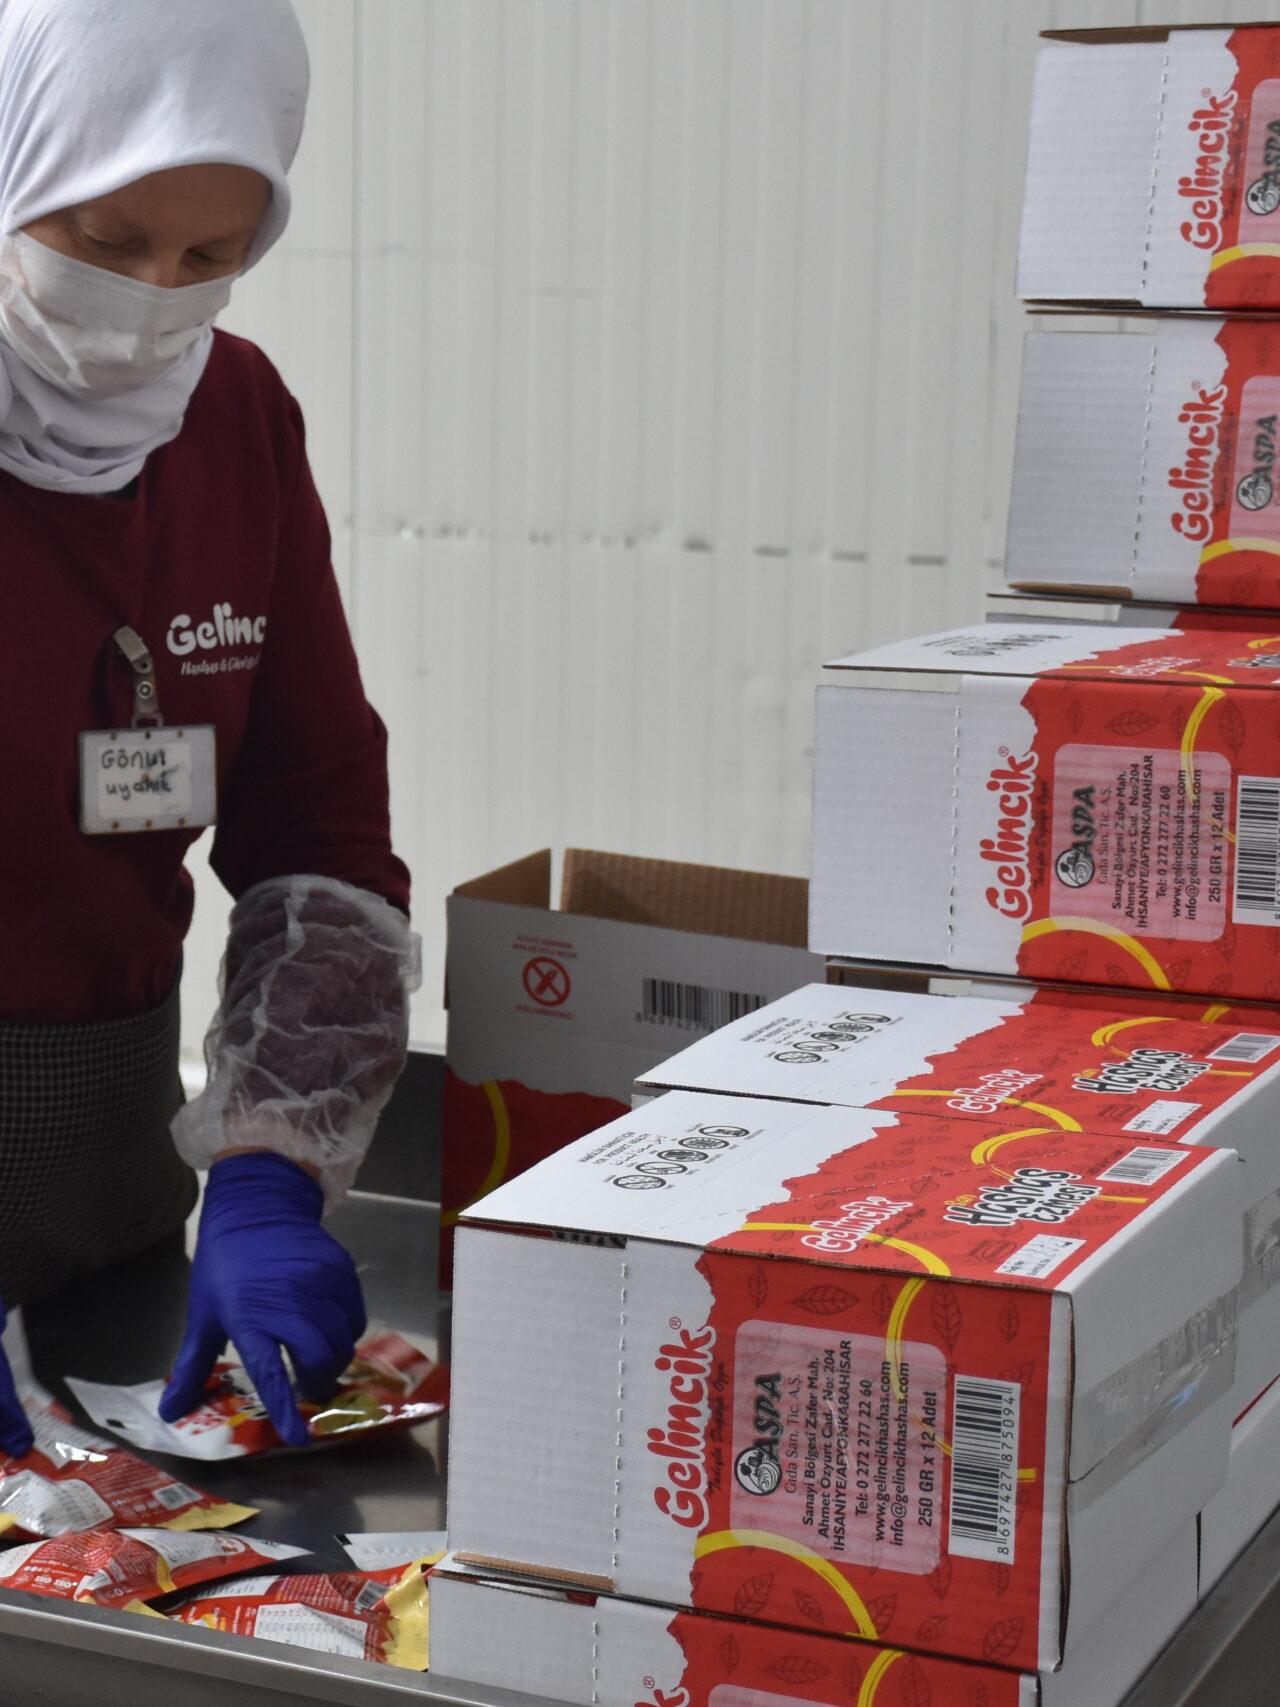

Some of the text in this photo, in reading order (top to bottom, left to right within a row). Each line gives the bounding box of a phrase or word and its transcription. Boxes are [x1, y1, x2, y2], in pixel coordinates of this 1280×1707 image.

[1178, 90, 1237, 249] Gelincik
[1168, 388, 1224, 541] Gelincik
[1252, 414, 1278, 483] ASPA
[1072, 785, 1097, 857] ASPA
[1115, 801, 1126, 830] Zafer
[1116, 770, 1128, 799] Mah.
[1128, 813, 1139, 837] Cad.
[1130, 763, 1140, 783] 204
[980, 755, 1035, 919] Gelincik
[1112, 875, 1125, 910] Sanayi
[1156, 785, 1171, 898] Tel: 0 272 277 22 60
[1172, 770, 1187, 919] www.gelincikhashas.com
[1185, 769, 1202, 921] info@gelincikhashas.com
[1209, 791, 1225, 904] 250 GR x 12 Adet
[1125, 881, 1137, 919] Ahmet
[947, 1070, 1043, 1113] Gelincik
[1073, 1049, 1191, 1093] Haşhaş
[1138, 1062, 1211, 1092] Ezmesi
[801, 1196, 914, 1253] Gelincik
[944, 1168, 1082, 1226] Haşhaş
[1019, 1184, 1102, 1224] Ezmesi
[647, 1329, 712, 1528] Gelincik
[753, 1372, 784, 1462] ASPA
[784, 1374, 803, 1494] Gıda San. Tic. A.Ş.
[802, 1357, 820, 1526] Sanayi Bölgesi Zafer Mah.
[817, 1349, 836, 1539] Ahmet Özyurt Cad. No: 204
[830, 1340, 852, 1551] İHSANİYE/AFYONKARAHİSAR
[855, 1379, 873, 1516] Tel: 0 272 277 22 60
[874, 1361, 891, 1541] www.gelincikhashas.com
[890, 1362, 910, 1546] info@gelincikhashas.com
[918, 1391, 938, 1528] 250 GR x 12 Adet
